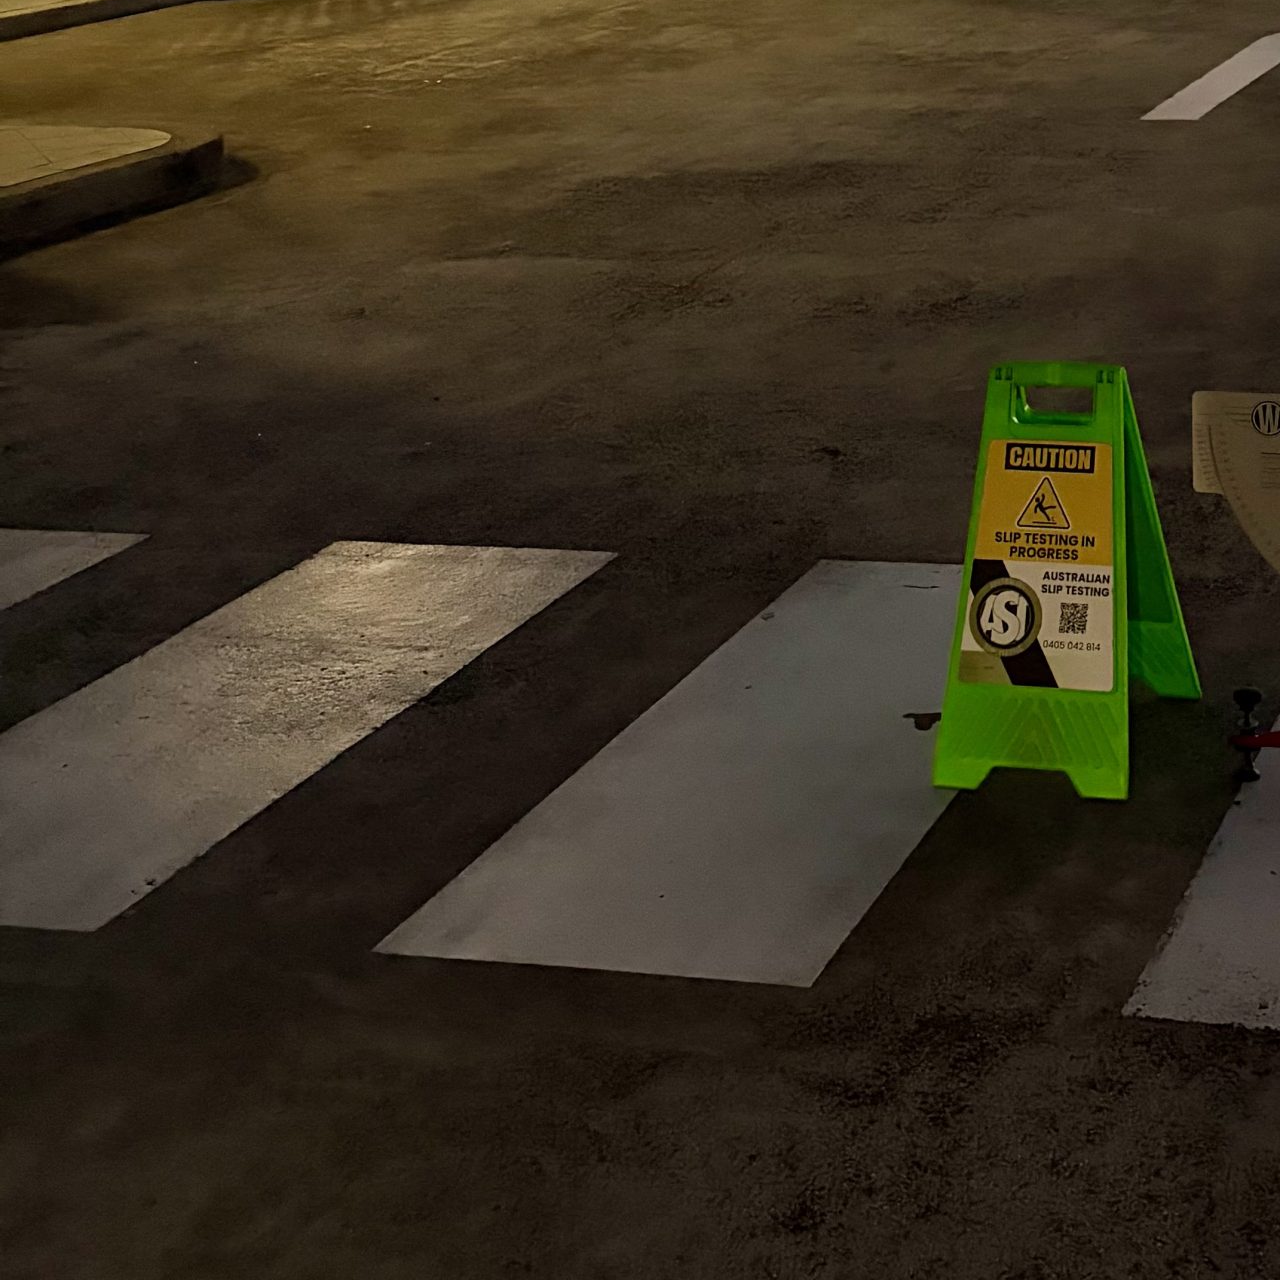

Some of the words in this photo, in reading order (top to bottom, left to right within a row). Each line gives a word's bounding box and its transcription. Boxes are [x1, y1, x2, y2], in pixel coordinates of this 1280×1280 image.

[1009, 446, 1092, 470] CAUTION
[995, 531, 1021, 543] SLIP
[1024, 533, 1078, 546] TESTING
[1081, 536, 1095, 547] IN
[1009, 546, 1079, 560] PROGRESS
[1043, 571, 1110, 584] AUSTRALIAN
[1041, 584, 1063, 594] SLIP
[1066, 586, 1110, 597] TESTING
[1042, 640, 1065, 649] 0405
[1067, 641, 1084, 650] 042
[1086, 643, 1101, 651] 814
